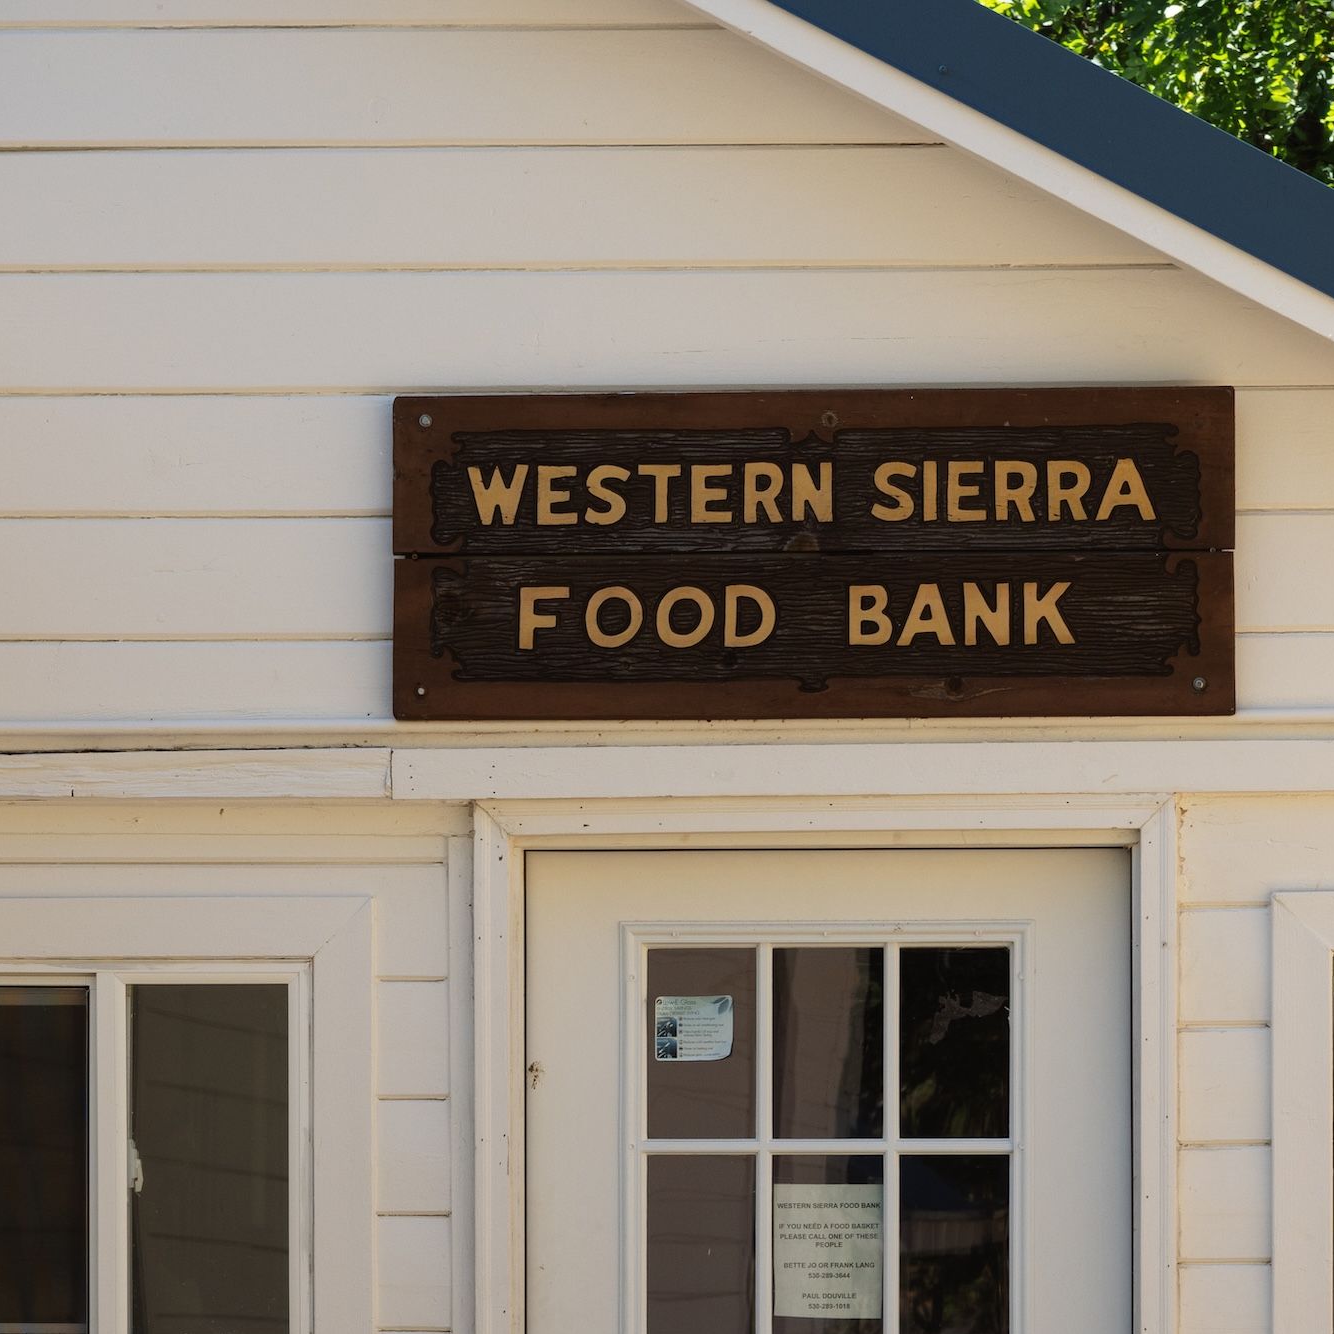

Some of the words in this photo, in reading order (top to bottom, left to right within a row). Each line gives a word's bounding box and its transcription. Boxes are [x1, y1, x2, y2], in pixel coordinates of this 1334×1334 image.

[467, 463, 834, 526] WESTERN
[871, 458, 1157, 523] SIERRA
[517, 584, 777, 651] FOOD
[848, 581, 1077, 648] BANK
